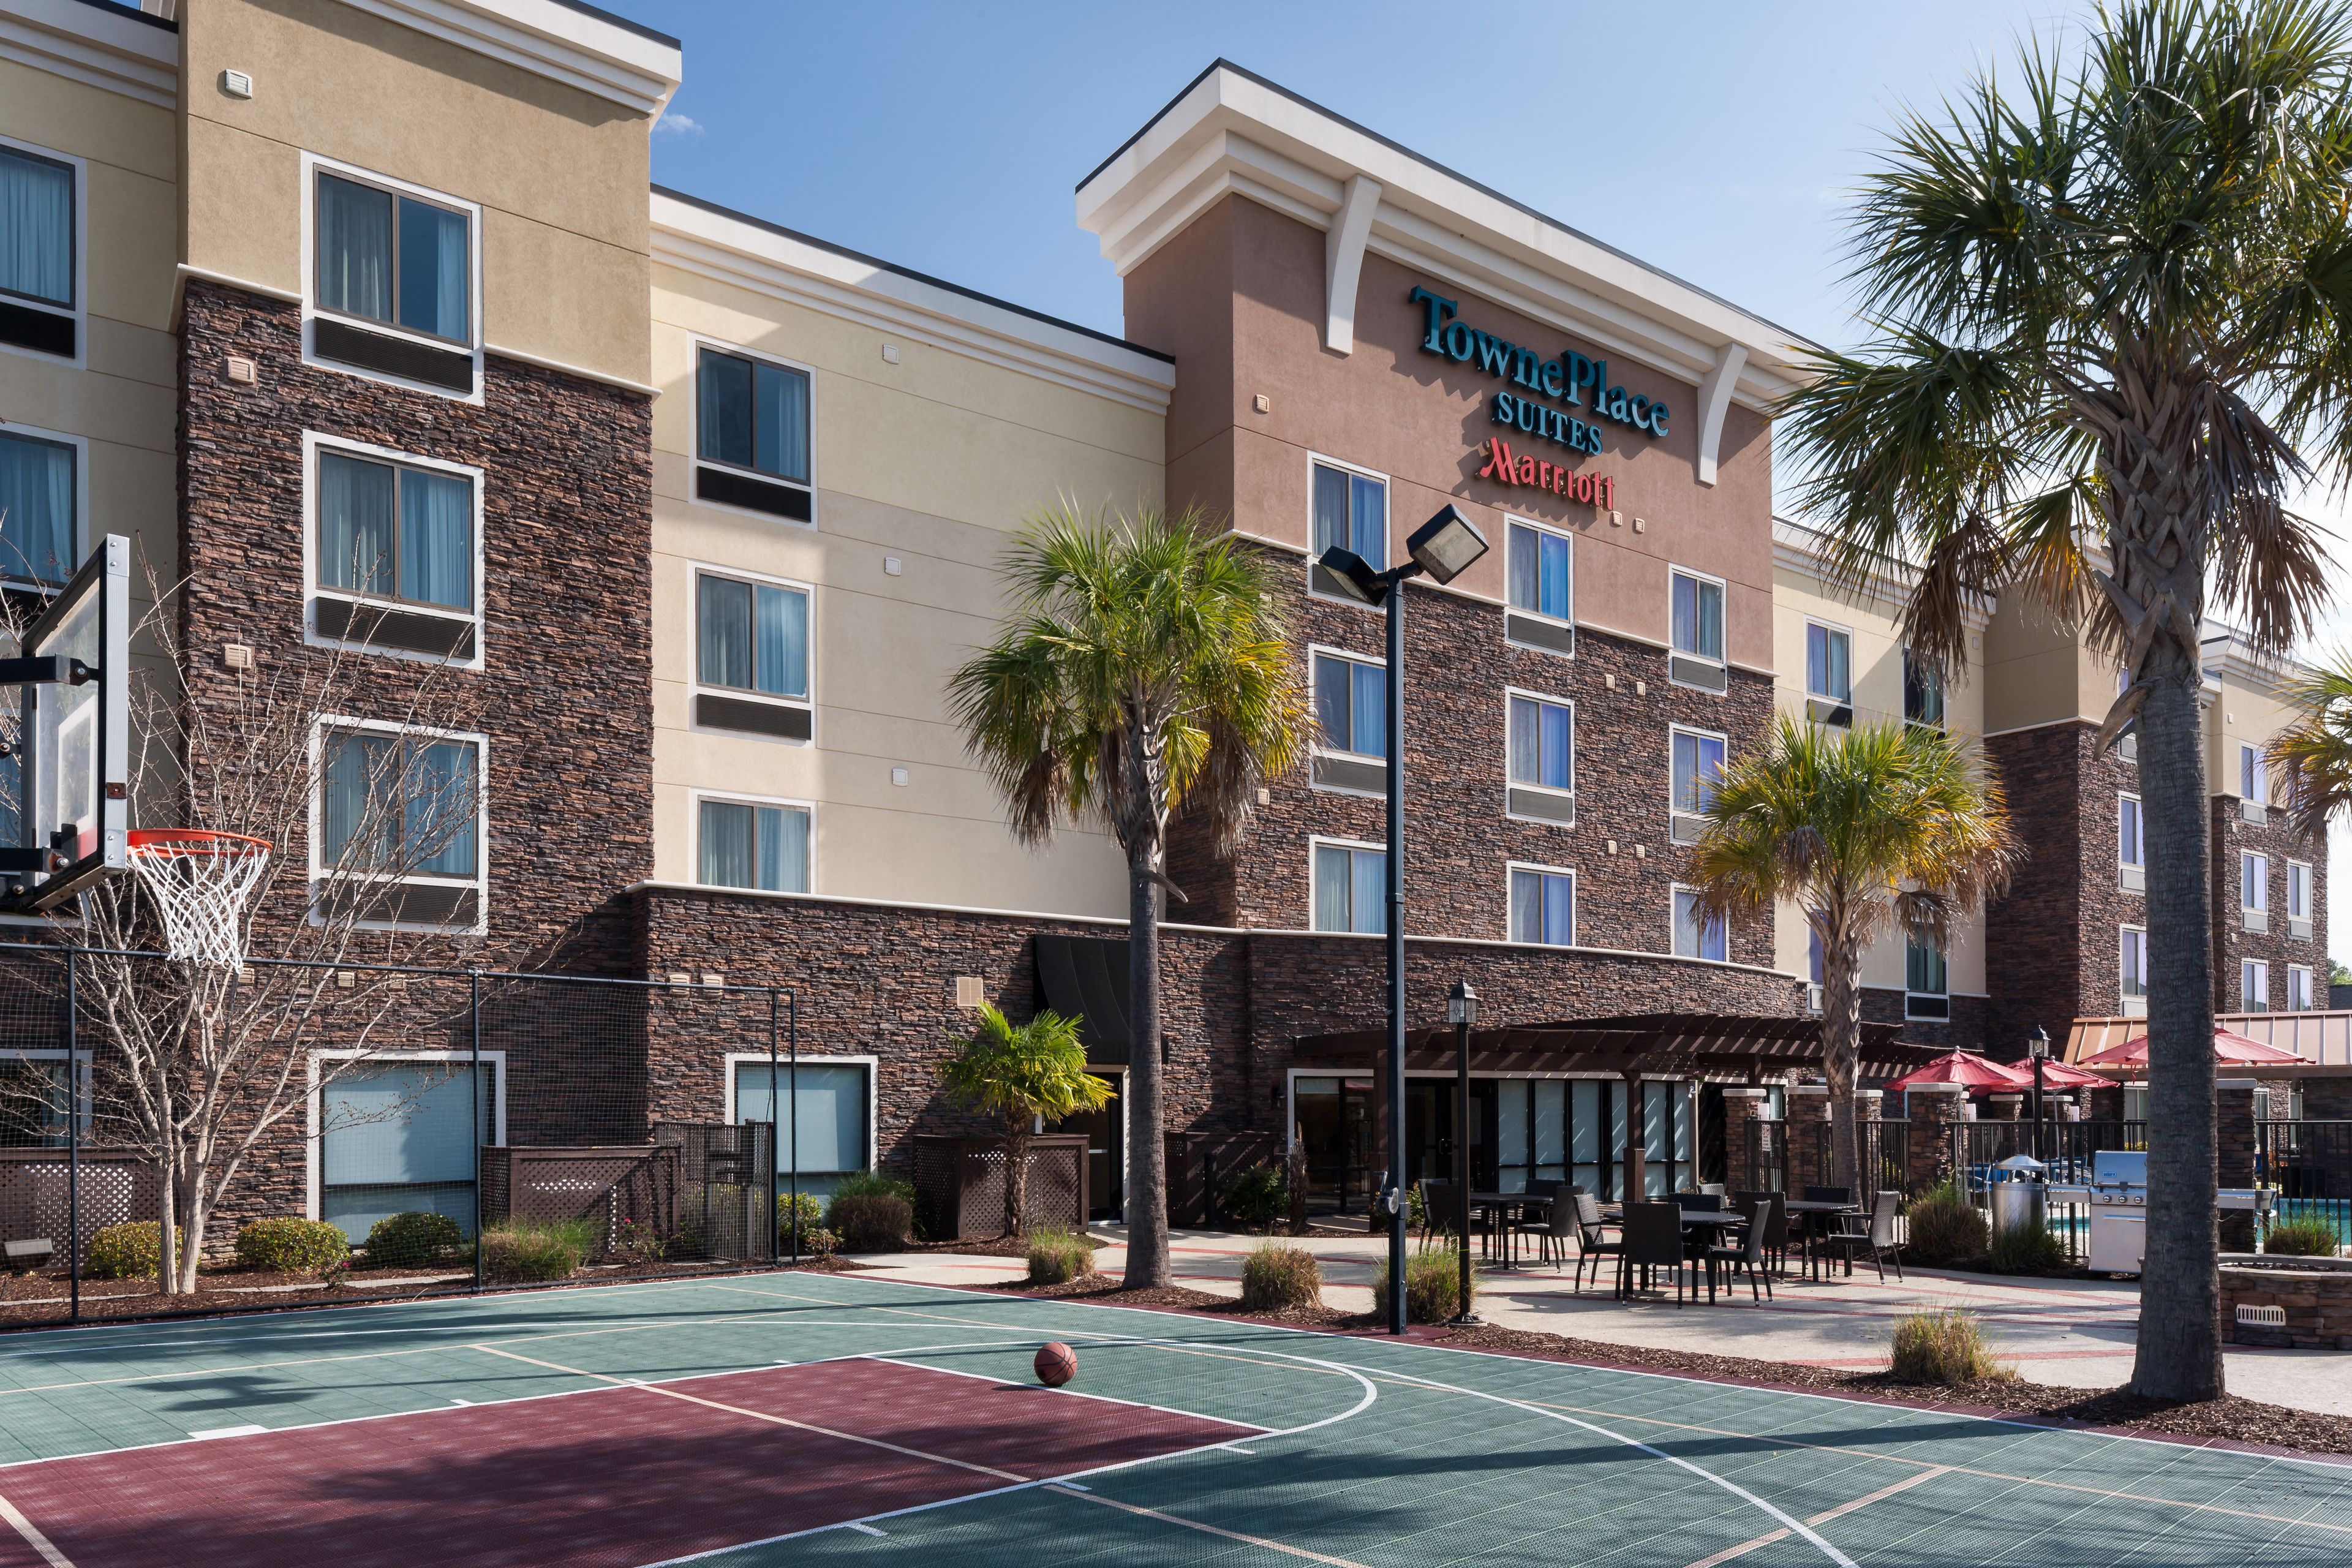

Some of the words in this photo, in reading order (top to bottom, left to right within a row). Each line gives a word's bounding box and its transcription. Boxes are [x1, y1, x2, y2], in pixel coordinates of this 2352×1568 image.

[1409, 285, 1670, 438] TownePlace
[1492, 391, 1603, 456] SUITES
[1476, 437, 1615, 511] Marriott
